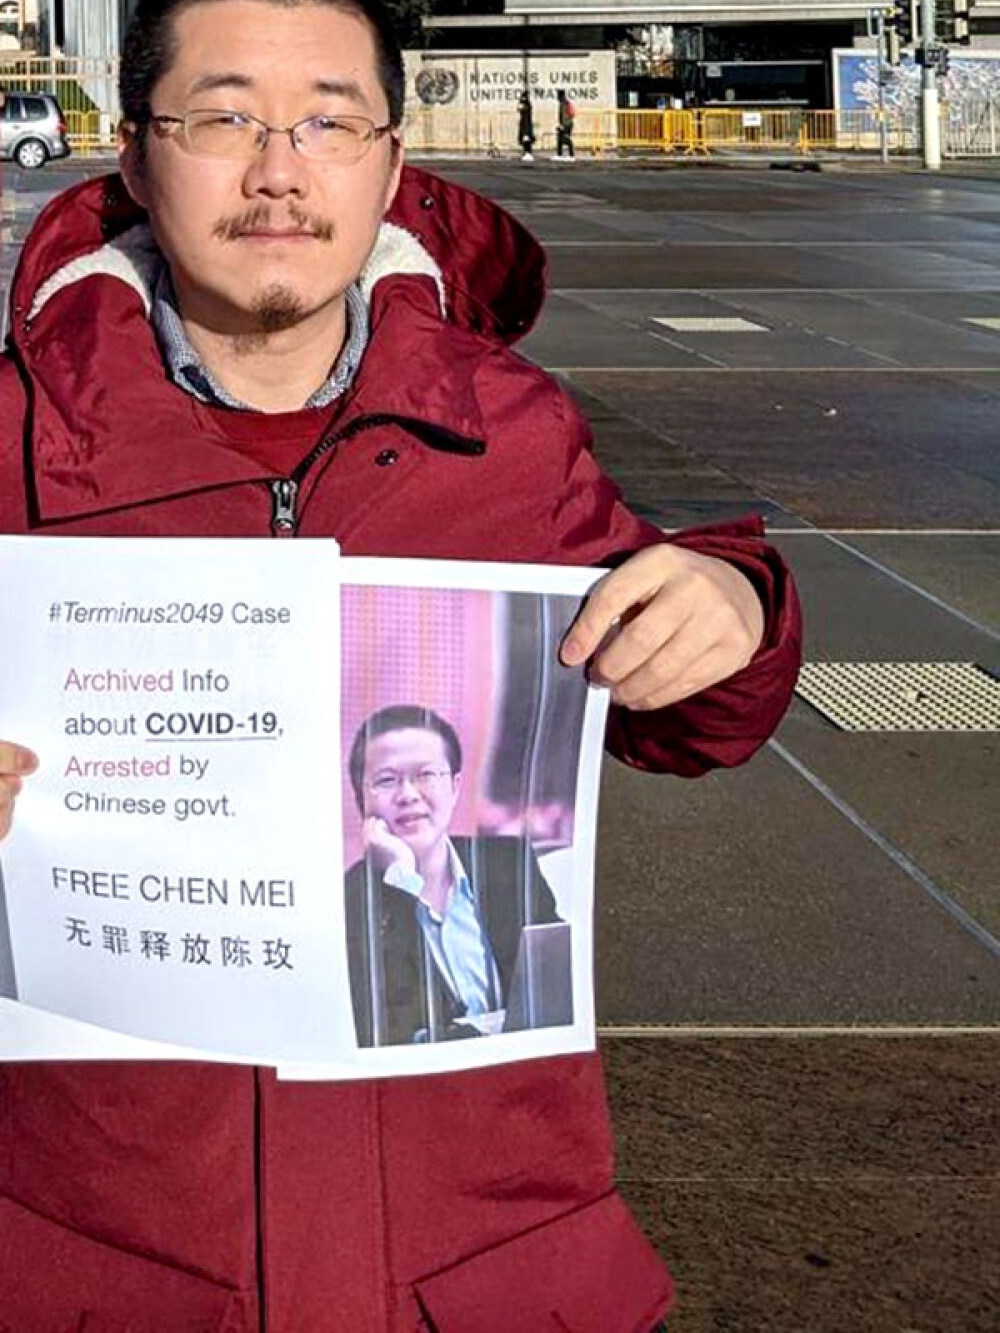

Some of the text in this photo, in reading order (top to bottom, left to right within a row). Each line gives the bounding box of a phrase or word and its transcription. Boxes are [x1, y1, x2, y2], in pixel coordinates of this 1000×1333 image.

[469, 71, 599, 84] NATIONS UNIES
[470, 87, 599, 101] UNITED NAONS
[49, 601, 291, 624] #Terminus2049 Case
[64, 668, 229, 692] Archived Info
[64, 711, 284, 737] about COVID-19,
[64, 754, 209, 781] Arrested by
[64, 791, 236, 821] Chinese govt.
[52, 866, 295, 907] FREE CHEN MEI
[65, 916, 294, 970] 无罪释放陈玫
